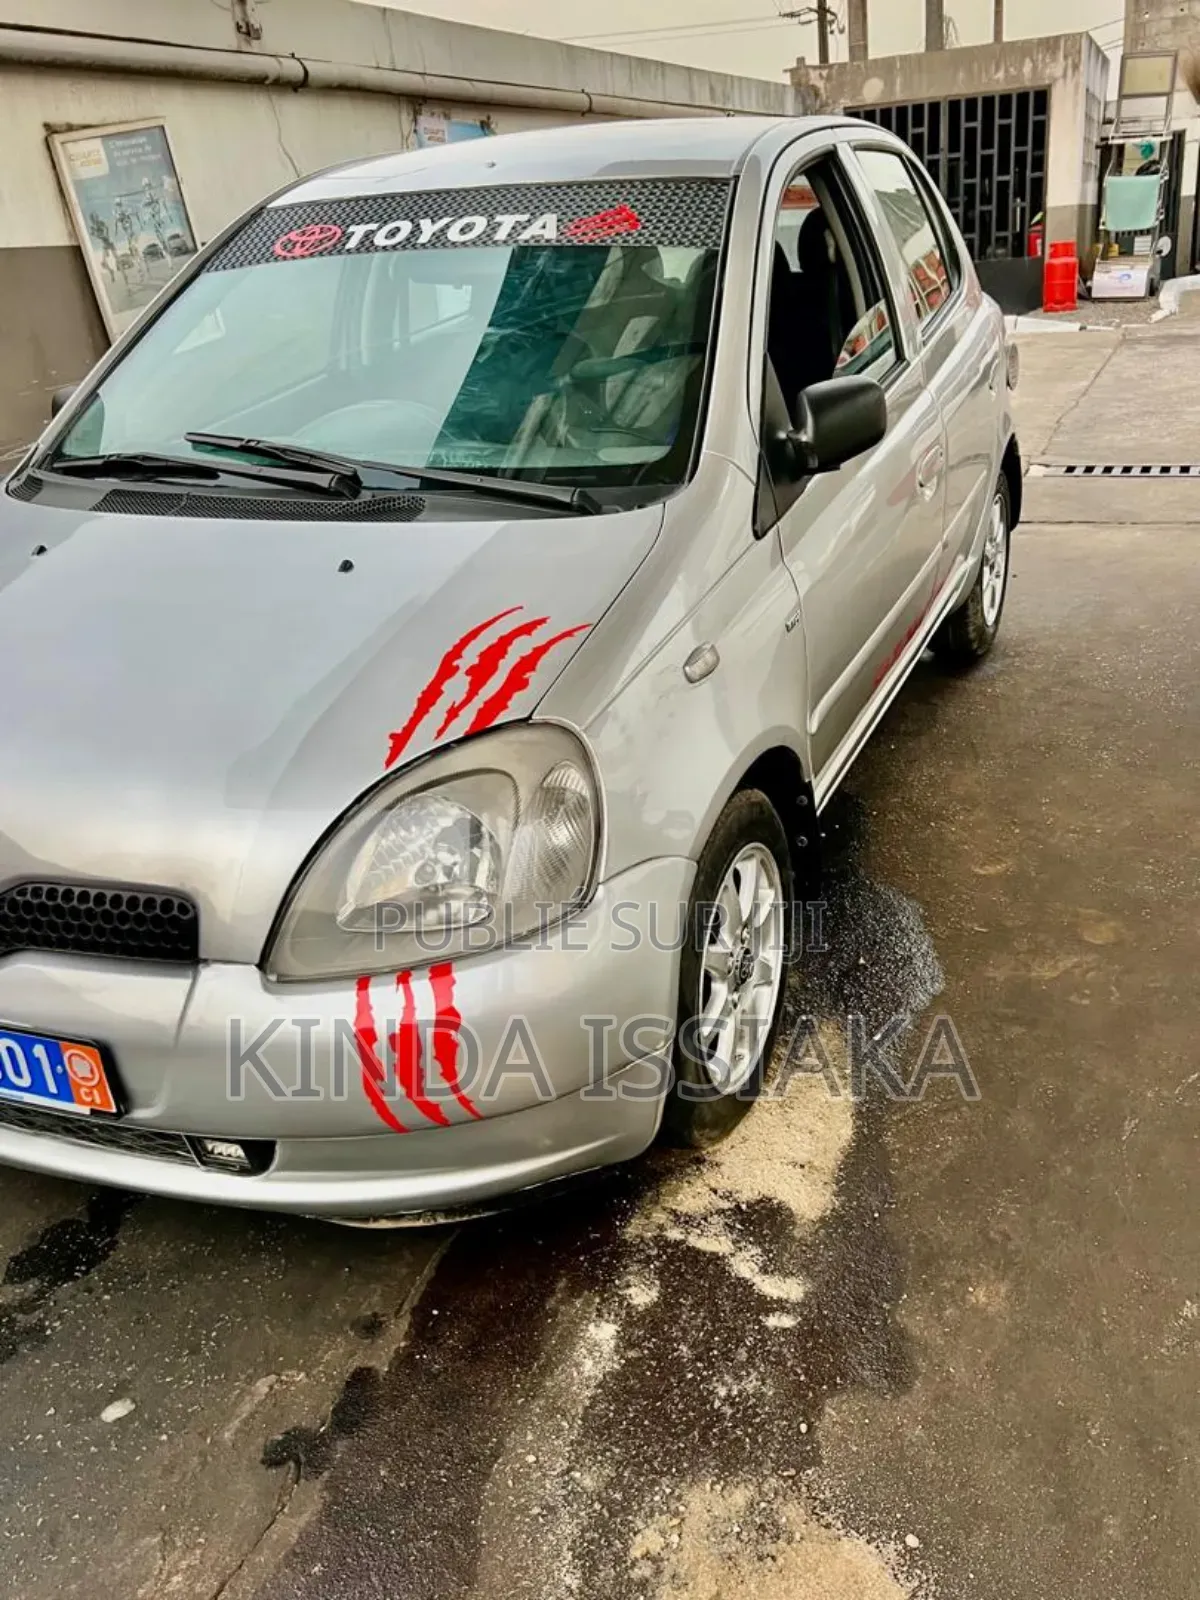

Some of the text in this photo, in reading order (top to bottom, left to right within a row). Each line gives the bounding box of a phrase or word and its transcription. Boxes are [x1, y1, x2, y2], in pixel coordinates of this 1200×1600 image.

[345, 213, 558, 249] TOYOTA
[0, 1037, 58, 1094] 01
[79, 1087, 101, 1104] CI
